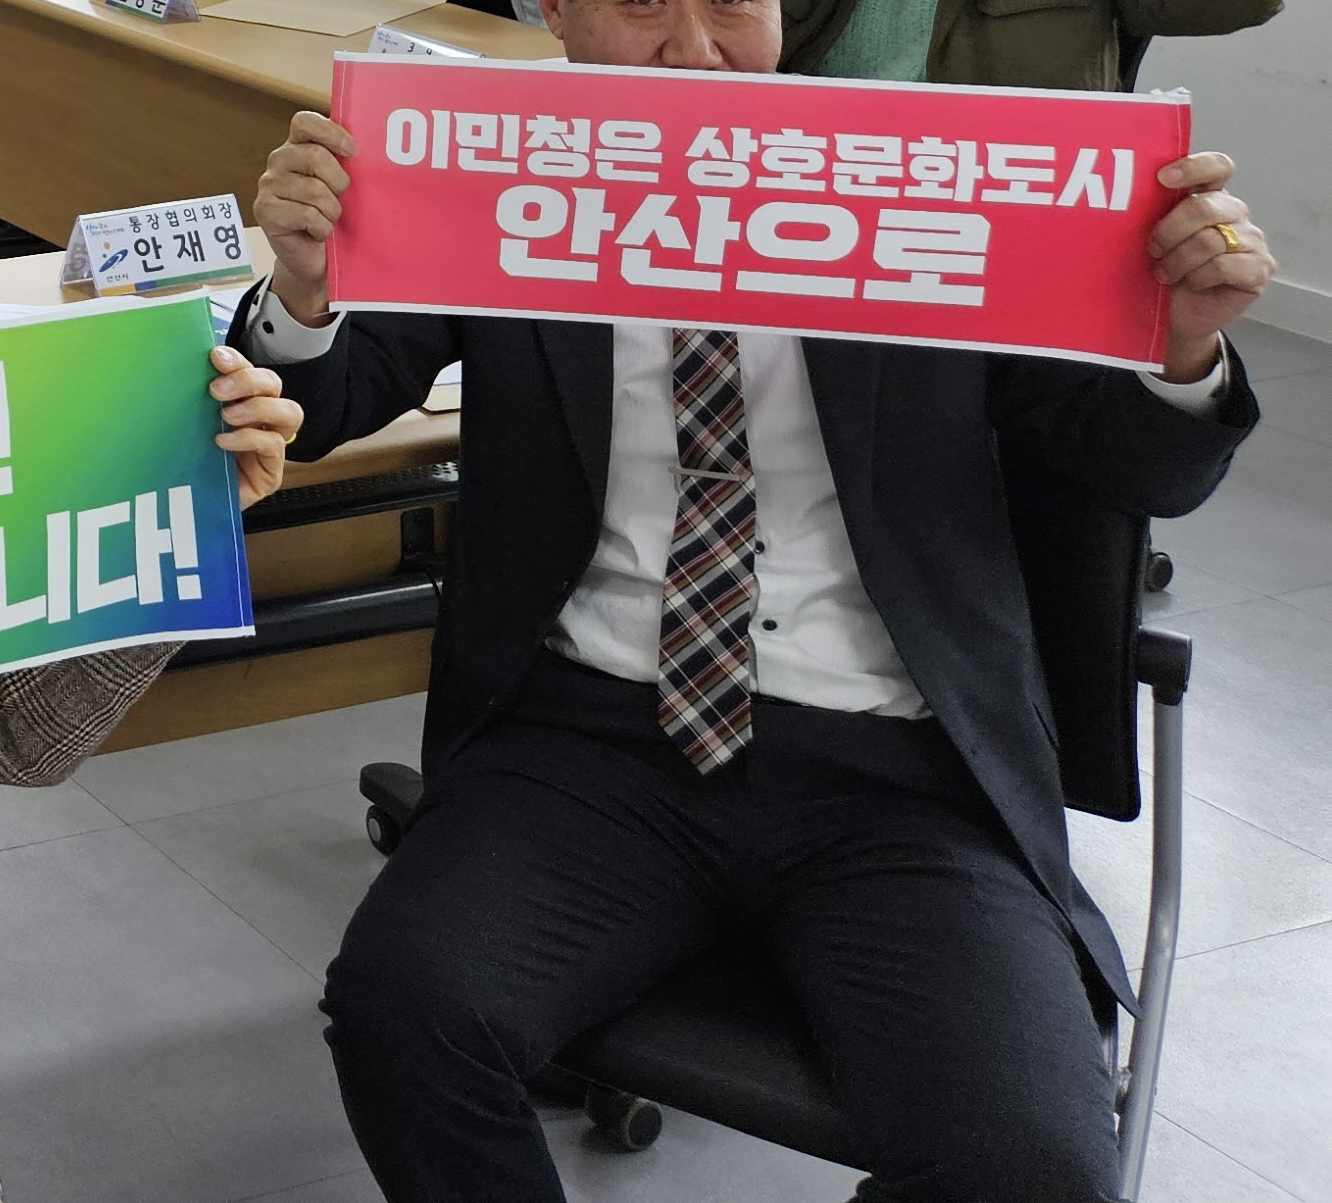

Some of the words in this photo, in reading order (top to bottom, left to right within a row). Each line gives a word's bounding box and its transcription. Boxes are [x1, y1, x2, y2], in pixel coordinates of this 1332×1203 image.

[385, 107, 663, 186] 이민청은
[683, 125, 1135, 212] 상호문화도시
[495, 184, 994, 307] 안산으로
